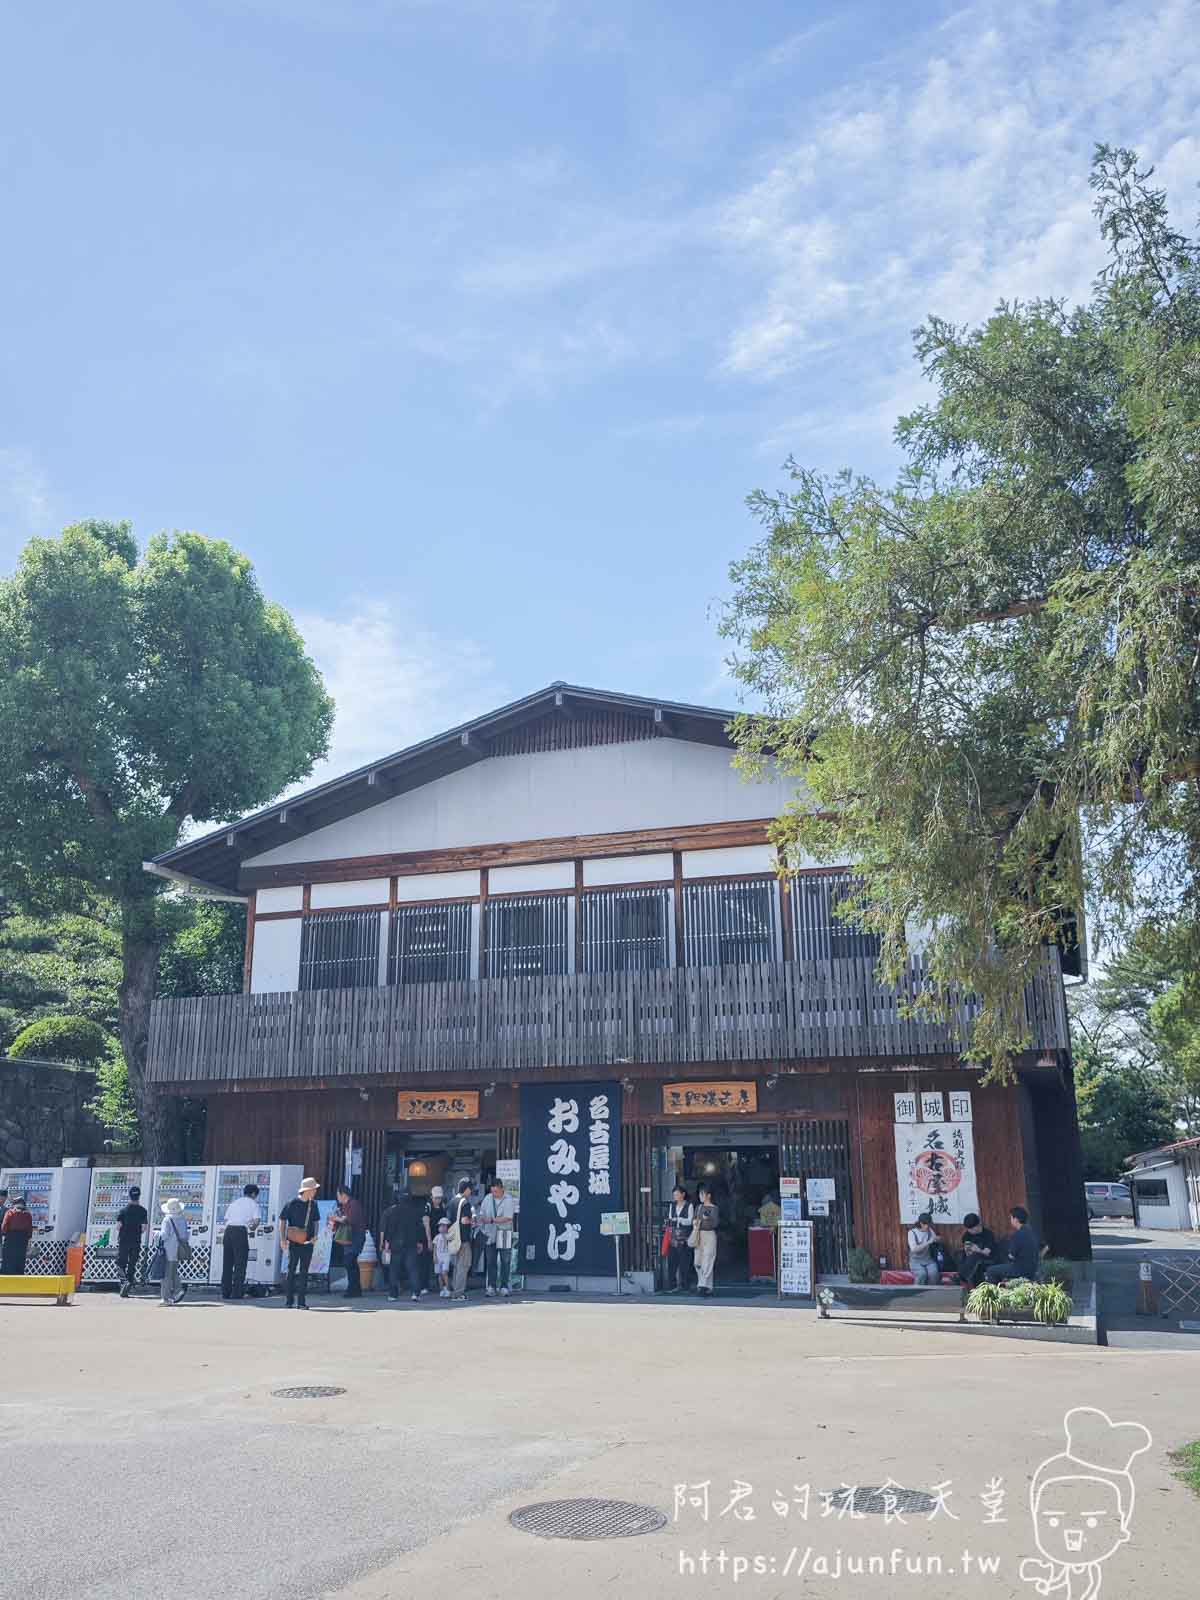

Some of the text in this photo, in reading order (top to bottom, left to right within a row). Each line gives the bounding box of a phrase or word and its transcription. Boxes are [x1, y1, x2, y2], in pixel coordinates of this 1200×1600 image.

[588, 1095, 611, 1195] 名古屋城
[896, 1098, 969, 1118] 御城印
[547, 1098, 582, 1260] おみやげ
[923, 1128, 952, 1217] 名古屋城
